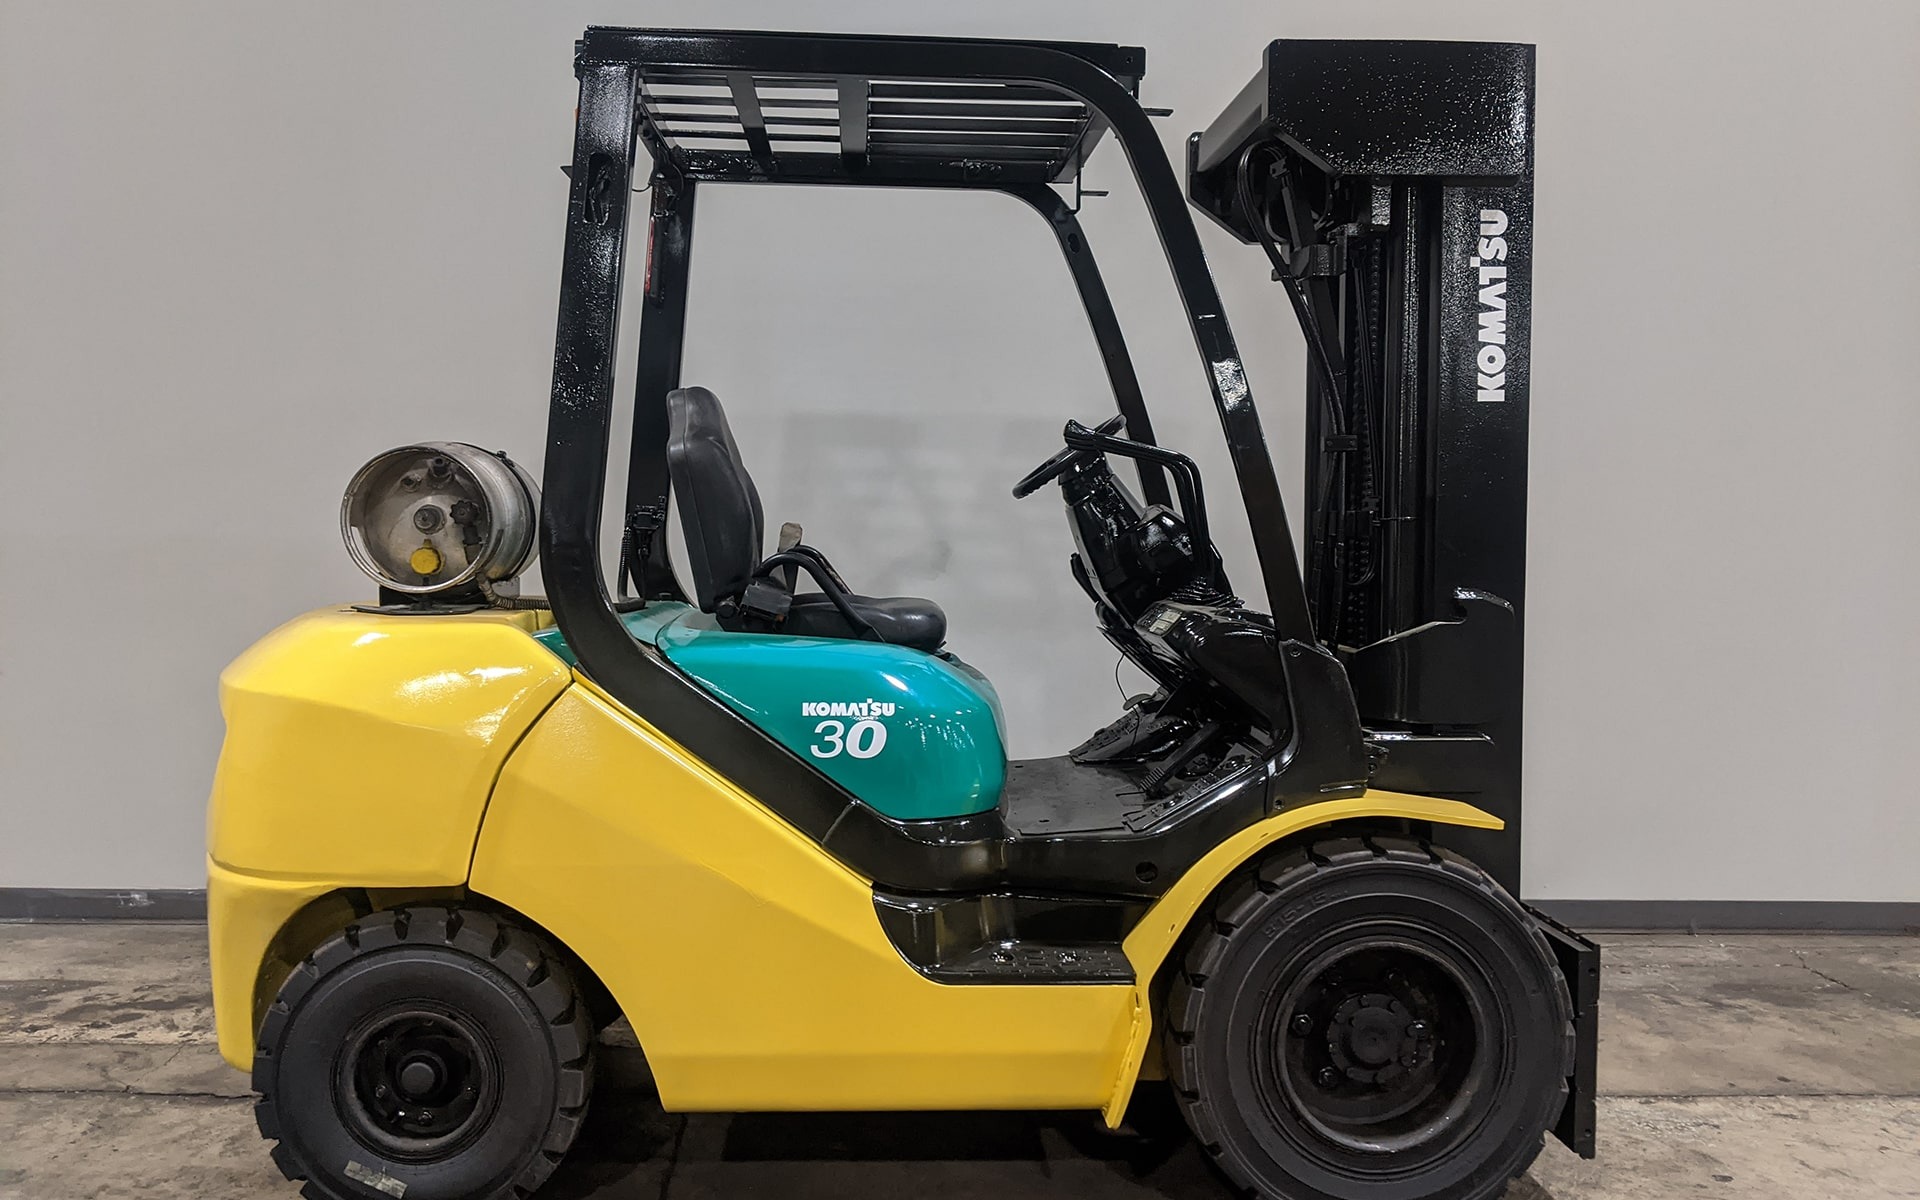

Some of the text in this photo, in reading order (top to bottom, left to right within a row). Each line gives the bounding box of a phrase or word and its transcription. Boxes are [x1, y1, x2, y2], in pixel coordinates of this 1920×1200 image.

[1470, 209, 1509, 402] KOMATSU
[802, 698, 896, 717] KOMATSU
[810, 719, 888, 759] 30
